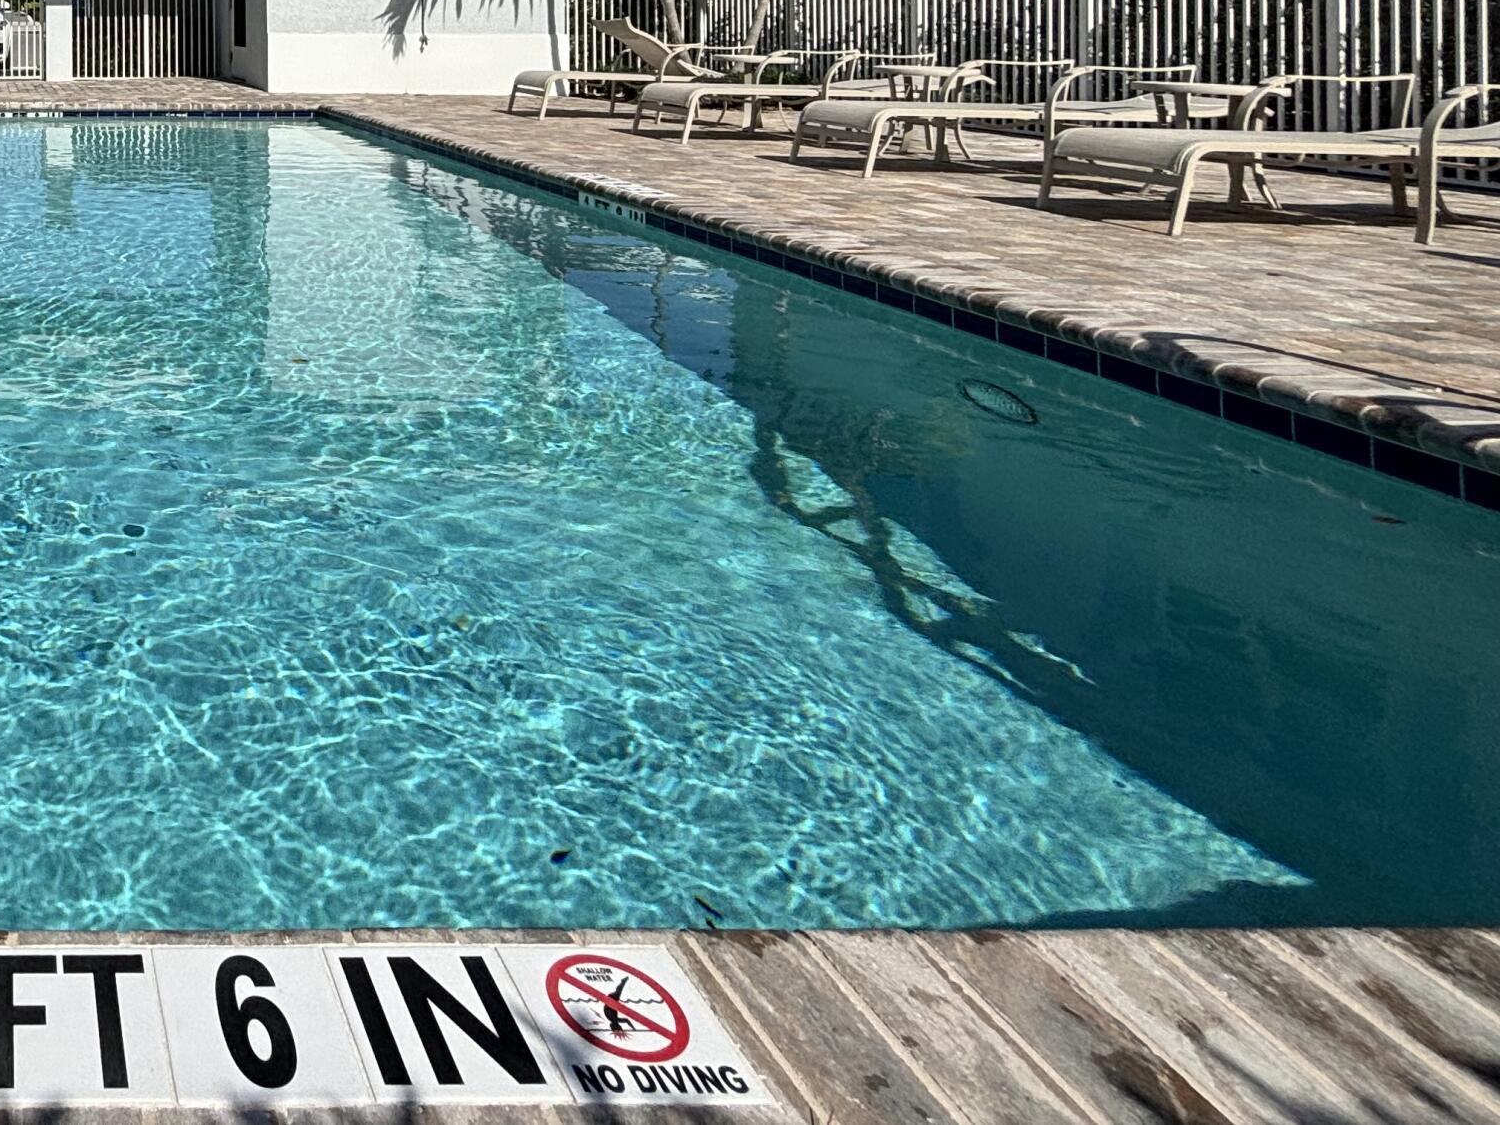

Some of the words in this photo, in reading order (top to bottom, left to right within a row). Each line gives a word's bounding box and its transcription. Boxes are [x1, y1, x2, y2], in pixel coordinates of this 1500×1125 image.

[584, 974, 614, 982] WATER
[215, 955, 298, 1089] 6
[339, 956, 547, 1086] IN
[571, 1064, 626, 1094] NO
[627, 1065, 750, 1094] DIVING
